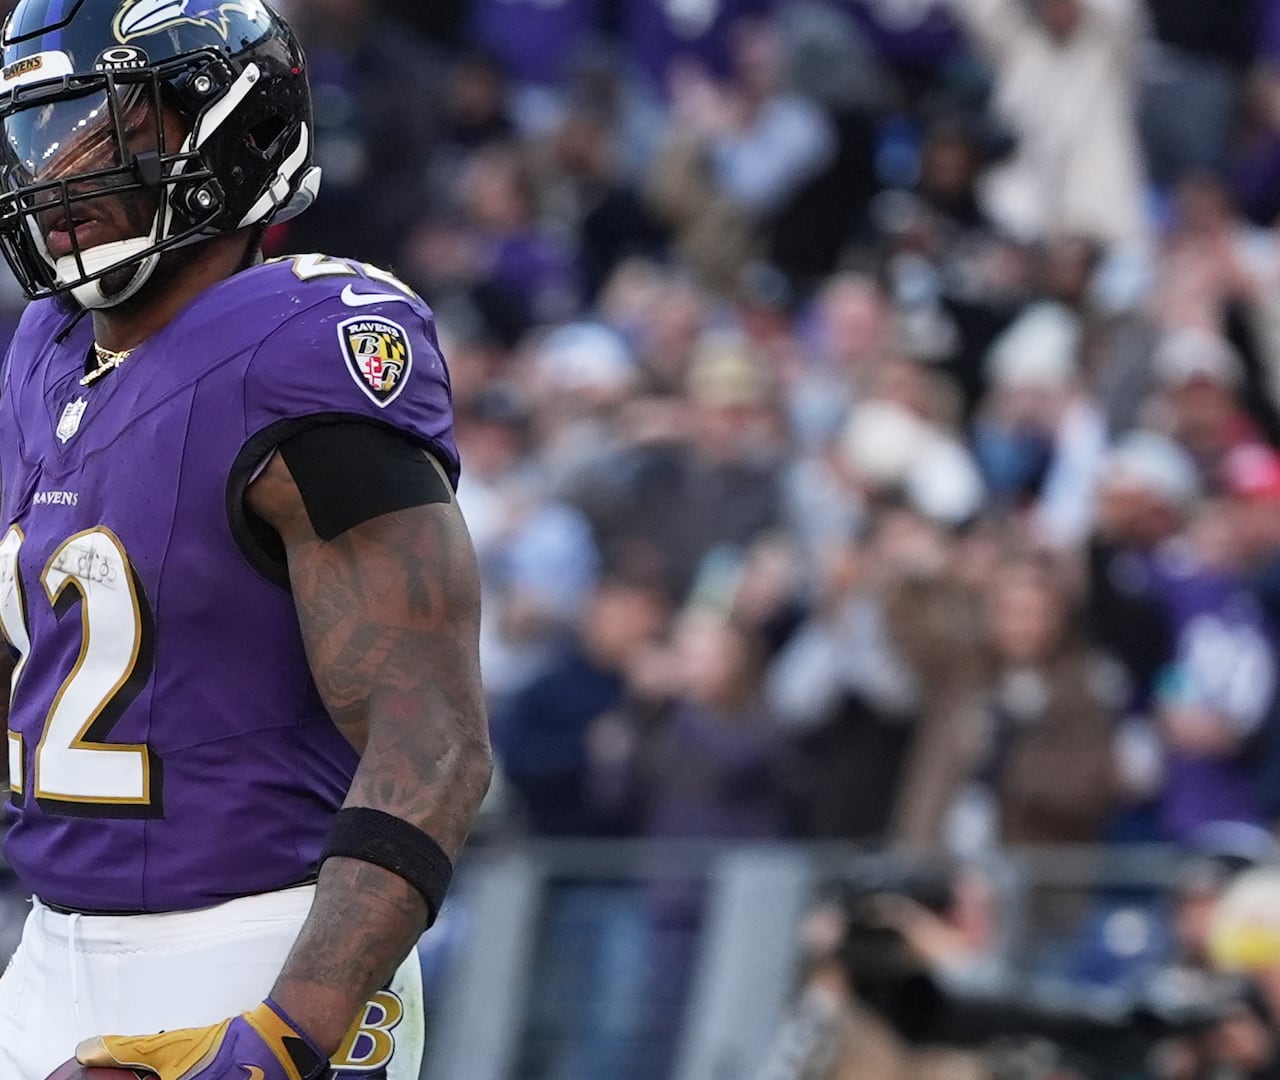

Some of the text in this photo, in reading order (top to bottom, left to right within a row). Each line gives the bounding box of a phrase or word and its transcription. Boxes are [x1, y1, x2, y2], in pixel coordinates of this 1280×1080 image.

[2, 56, 43, 80] RAVENS
[95, 60, 147, 72] OAKLEY
[347, 322, 400, 338] RAVENS
[32, 491, 79, 506] RAVENS
[329, 990, 404, 1070] B
